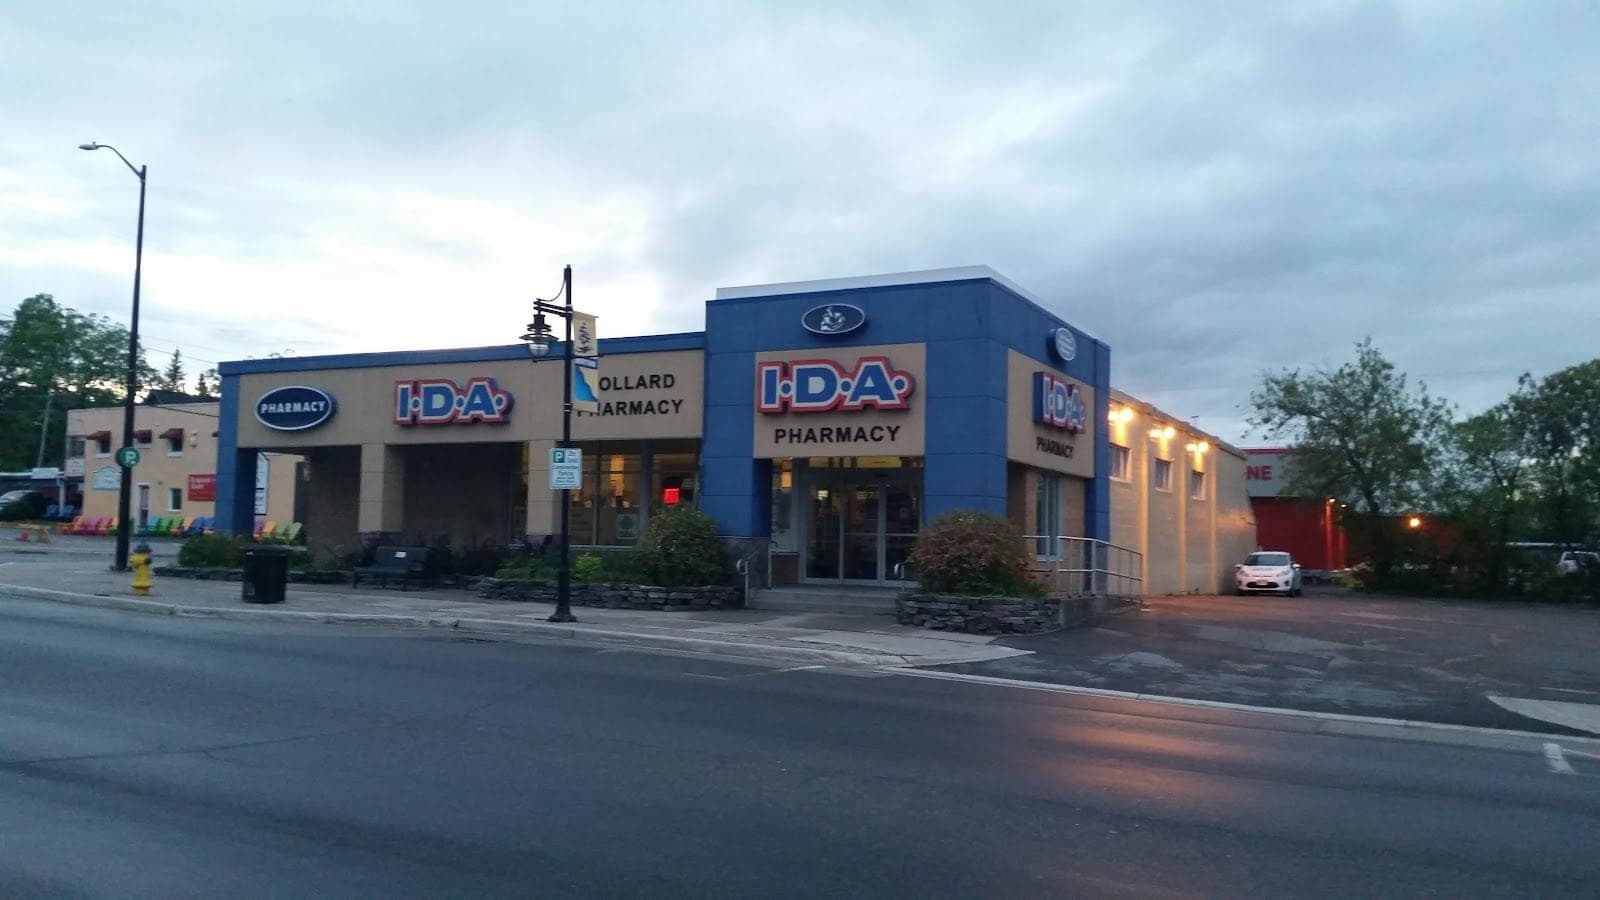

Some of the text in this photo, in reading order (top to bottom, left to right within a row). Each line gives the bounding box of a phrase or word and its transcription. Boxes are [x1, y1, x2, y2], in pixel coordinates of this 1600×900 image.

[598, 374, 675, 391] OLLARD
[261, 401, 326, 414] PHARMACY
[577, 399, 684, 417] ARMACY
[774, 425, 901, 444] PHARMACY
[1245, 465, 1272, 480] NE
